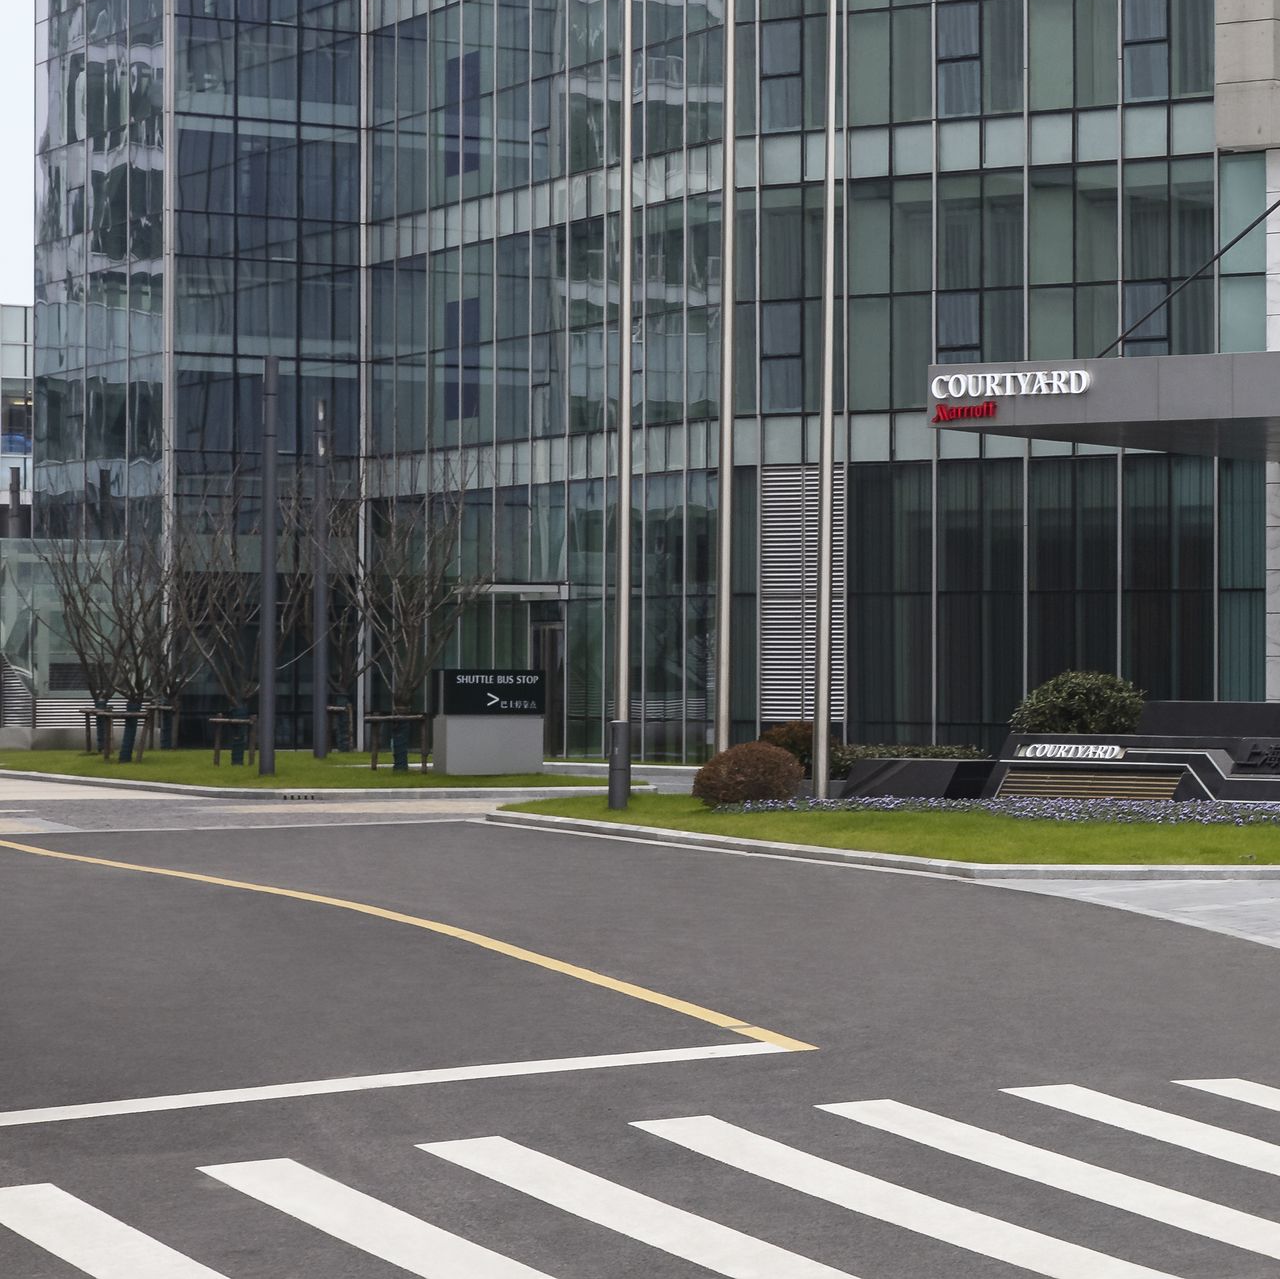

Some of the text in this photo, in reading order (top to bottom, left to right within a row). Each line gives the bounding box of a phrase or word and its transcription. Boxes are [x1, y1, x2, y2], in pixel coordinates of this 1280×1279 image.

[931, 370, 1092, 399] COURTYARD
[932, 401, 997, 423] Marriott
[456, 675, 539, 684] SHUTTLE BUS STOP
[1025, 744, 1121, 759] COURTYARD
